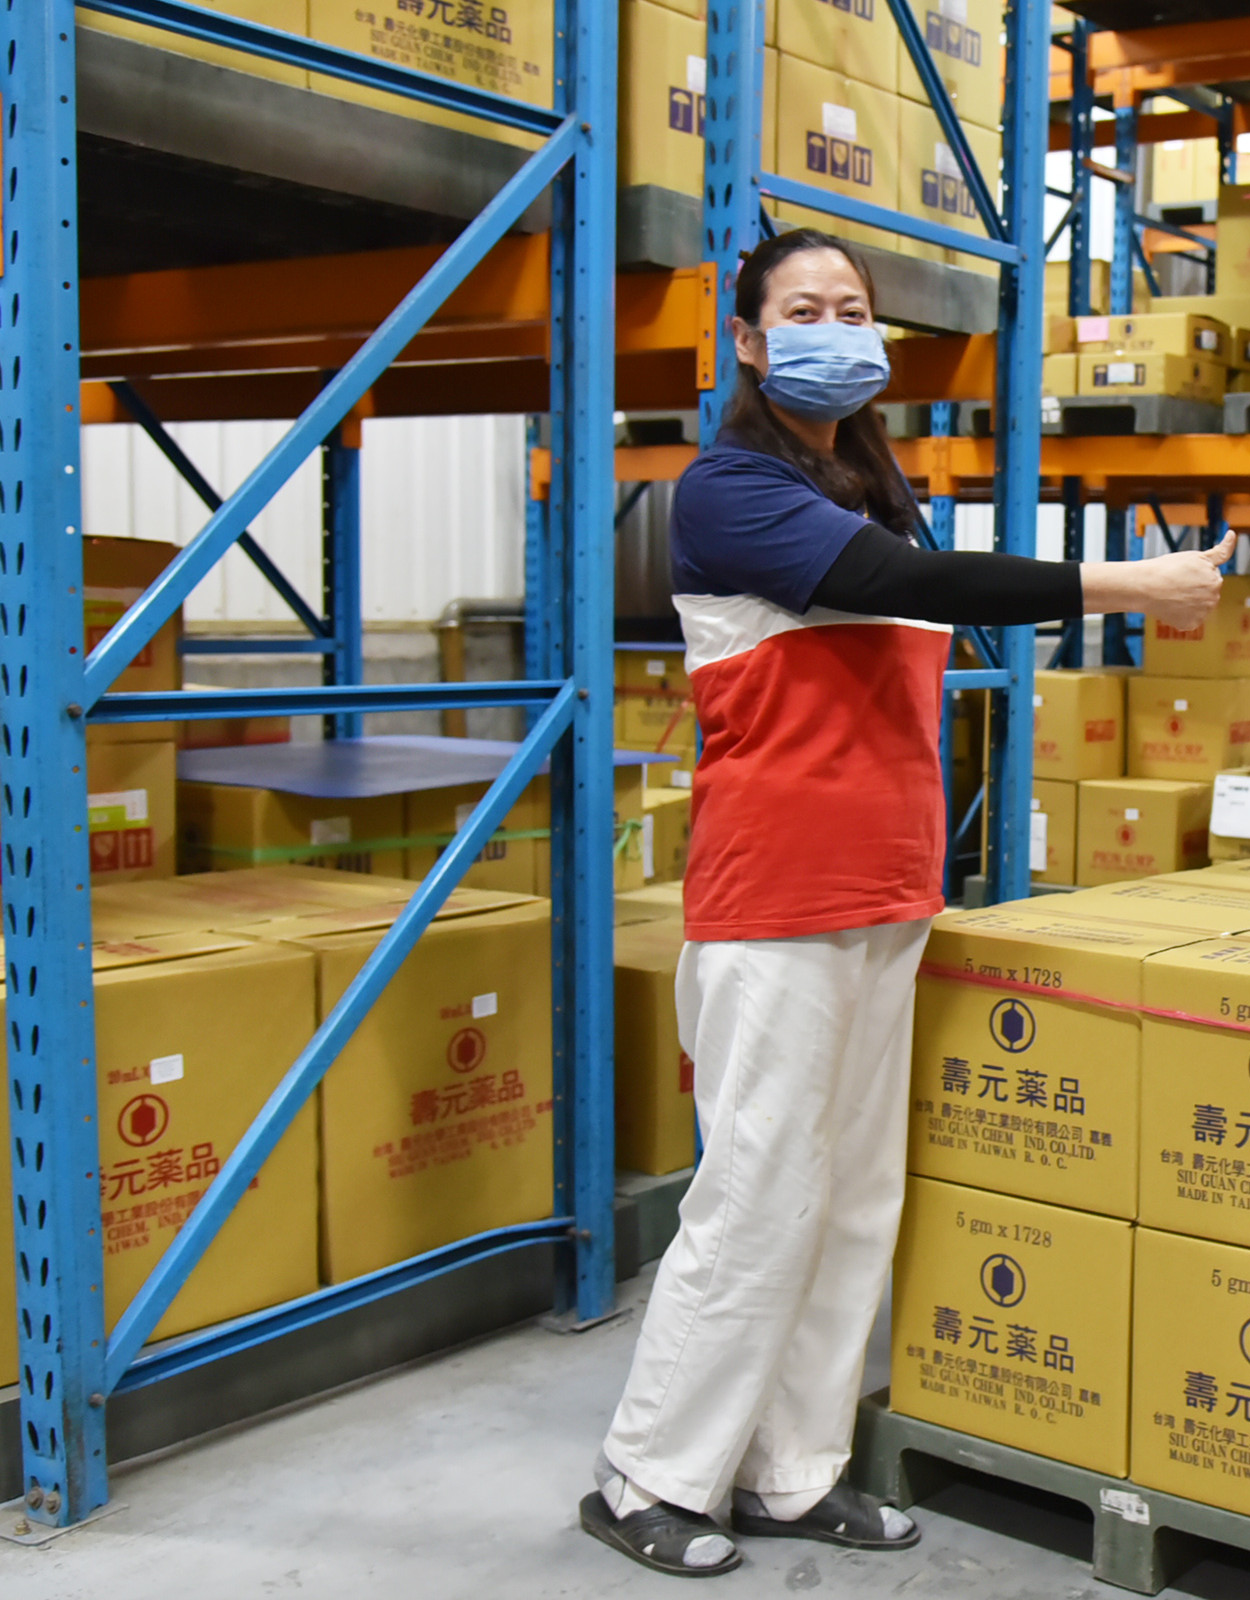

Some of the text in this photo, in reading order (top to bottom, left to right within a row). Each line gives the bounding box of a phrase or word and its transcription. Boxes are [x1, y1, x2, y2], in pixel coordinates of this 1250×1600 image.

[1007, 968, 1017, 981] x
[1023, 966, 1063, 989] 1728
[1220, 997, 1230, 1016] 5
[928, 1117, 947, 1132] SIU
[948, 1120, 979, 1139] GUAN
[981, 1126, 1014, 1146] CHEM
[1024, 1135, 1048, 1151] IND.
[928, 1132, 955, 1149] MADE
[957, 1138, 968, 1151] IN
[974, 1141, 1017, 1160] TAIWAN
[1177, 1169, 1198, 1185] SIU
[1200, 1173, 1236, 1192] GUAN
[1177, 1185, 1208, 1202] MADE
[1211, 1191, 1223, 1204] IN
[956, 1211, 1053, 1248] 5 gm x 1728
[1211, 1268, 1222, 1287] 5
[920, 1362, 937, 1378] SIU
[939, 1368, 970, 1388] GUAN
[972, 1376, 1004, 1398] CHEM
[920, 1376, 947, 1395] MADE
[948, 1385, 960, 1399] IN
[965, 1389, 1007, 1411] TAIWAN
[1169, 1431, 1189, 1449] SIU
[1192, 1438, 1228, 1459] GUAN
[1169, 1447, 1200, 1467] MADE
[1202, 1456, 1214, 1470] IN
